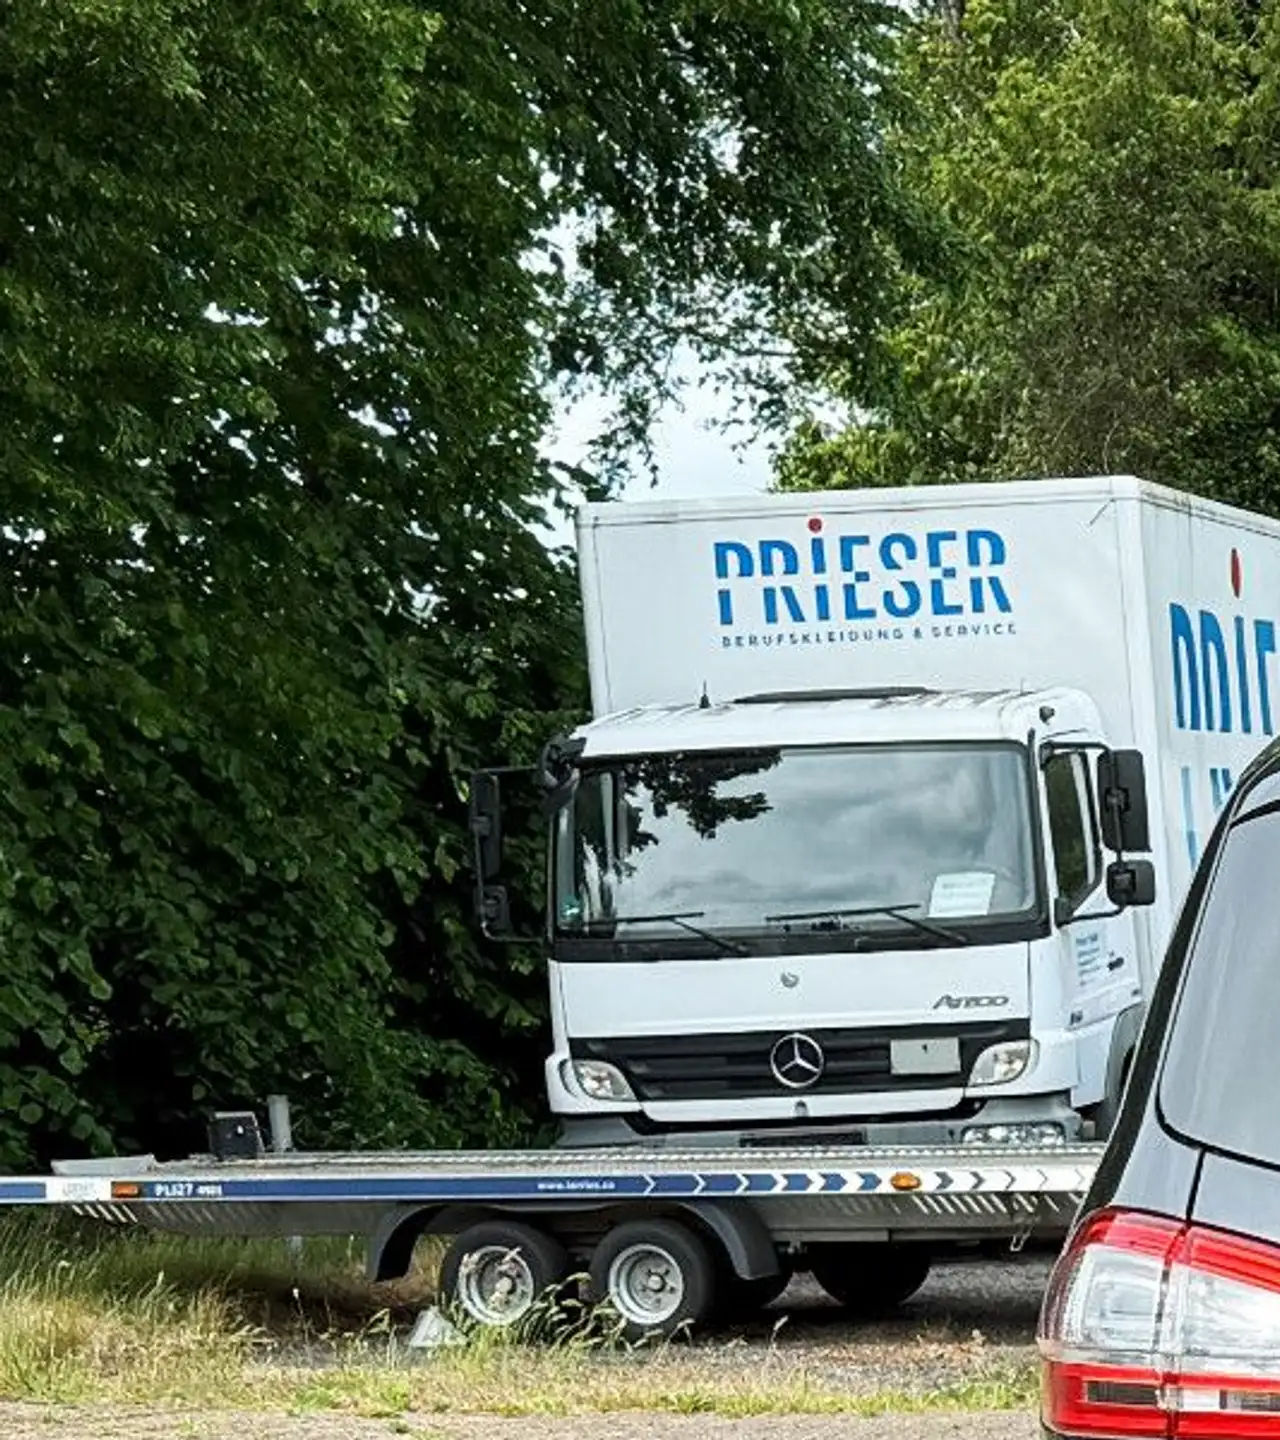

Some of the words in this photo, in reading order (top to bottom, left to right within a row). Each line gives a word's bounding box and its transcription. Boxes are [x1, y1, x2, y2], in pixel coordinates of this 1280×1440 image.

[713, 518, 1012, 625] PRIESER
[722, 628, 904, 648] BERUFSKLEIDUNG
[931, 623, 1017, 639] SERVICE
